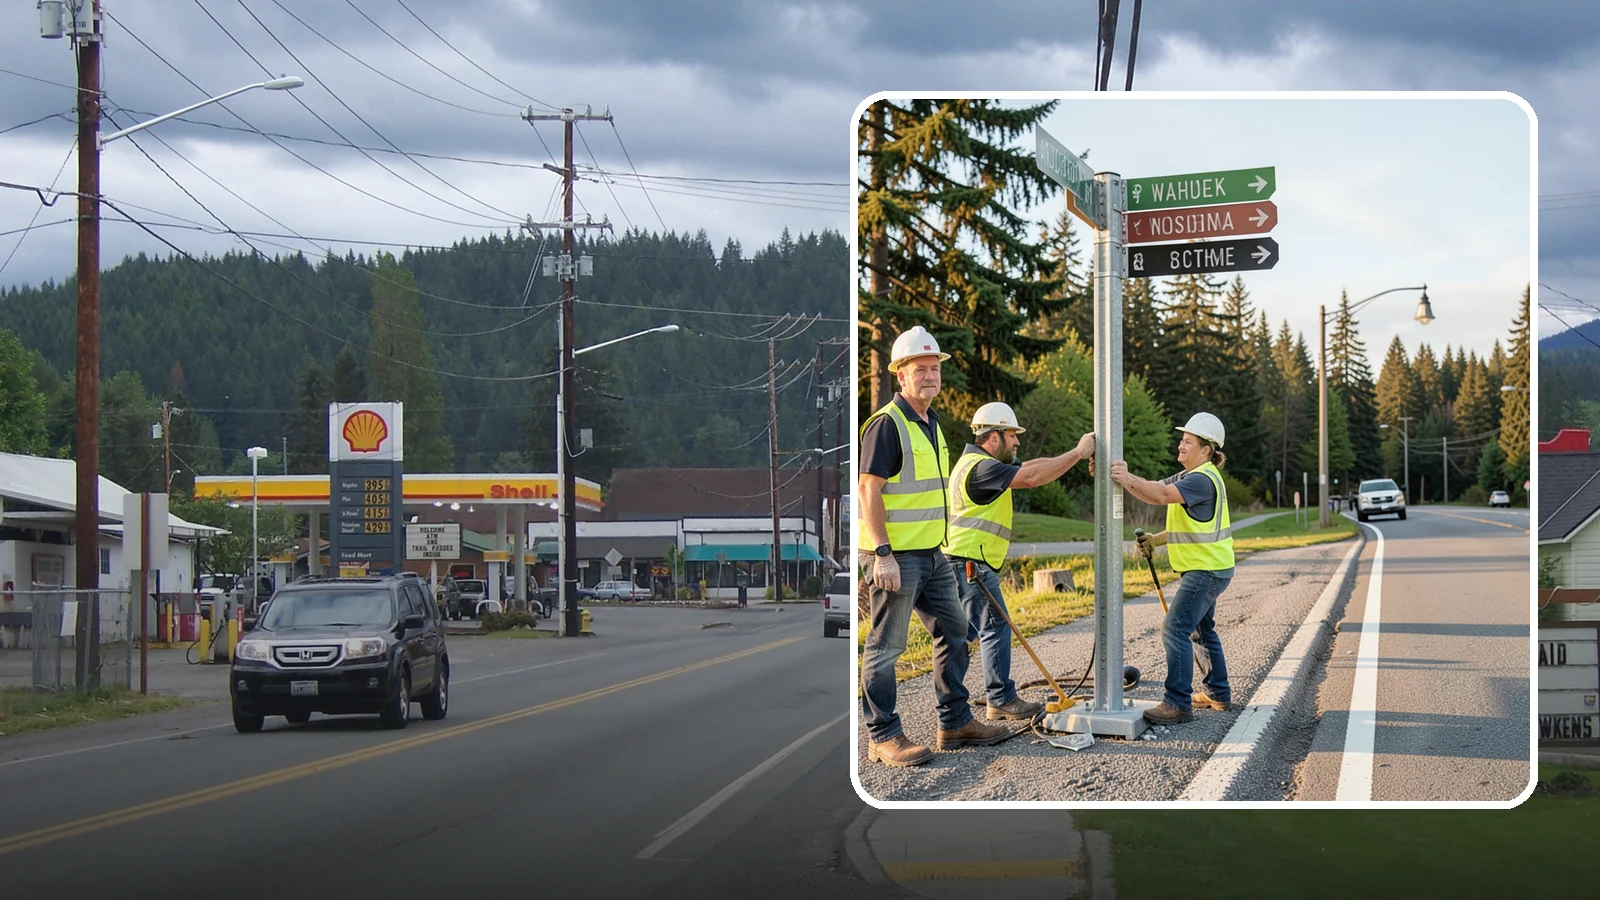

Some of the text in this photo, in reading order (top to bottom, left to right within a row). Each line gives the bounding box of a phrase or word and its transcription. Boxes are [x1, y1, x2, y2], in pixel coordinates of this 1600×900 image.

[366, 480, 383, 490] 395
[490, 484, 547, 499] Shell
[366, 494, 383, 504] 405
[366, 508, 383, 518] 415
[366, 522, 383, 532] 429
